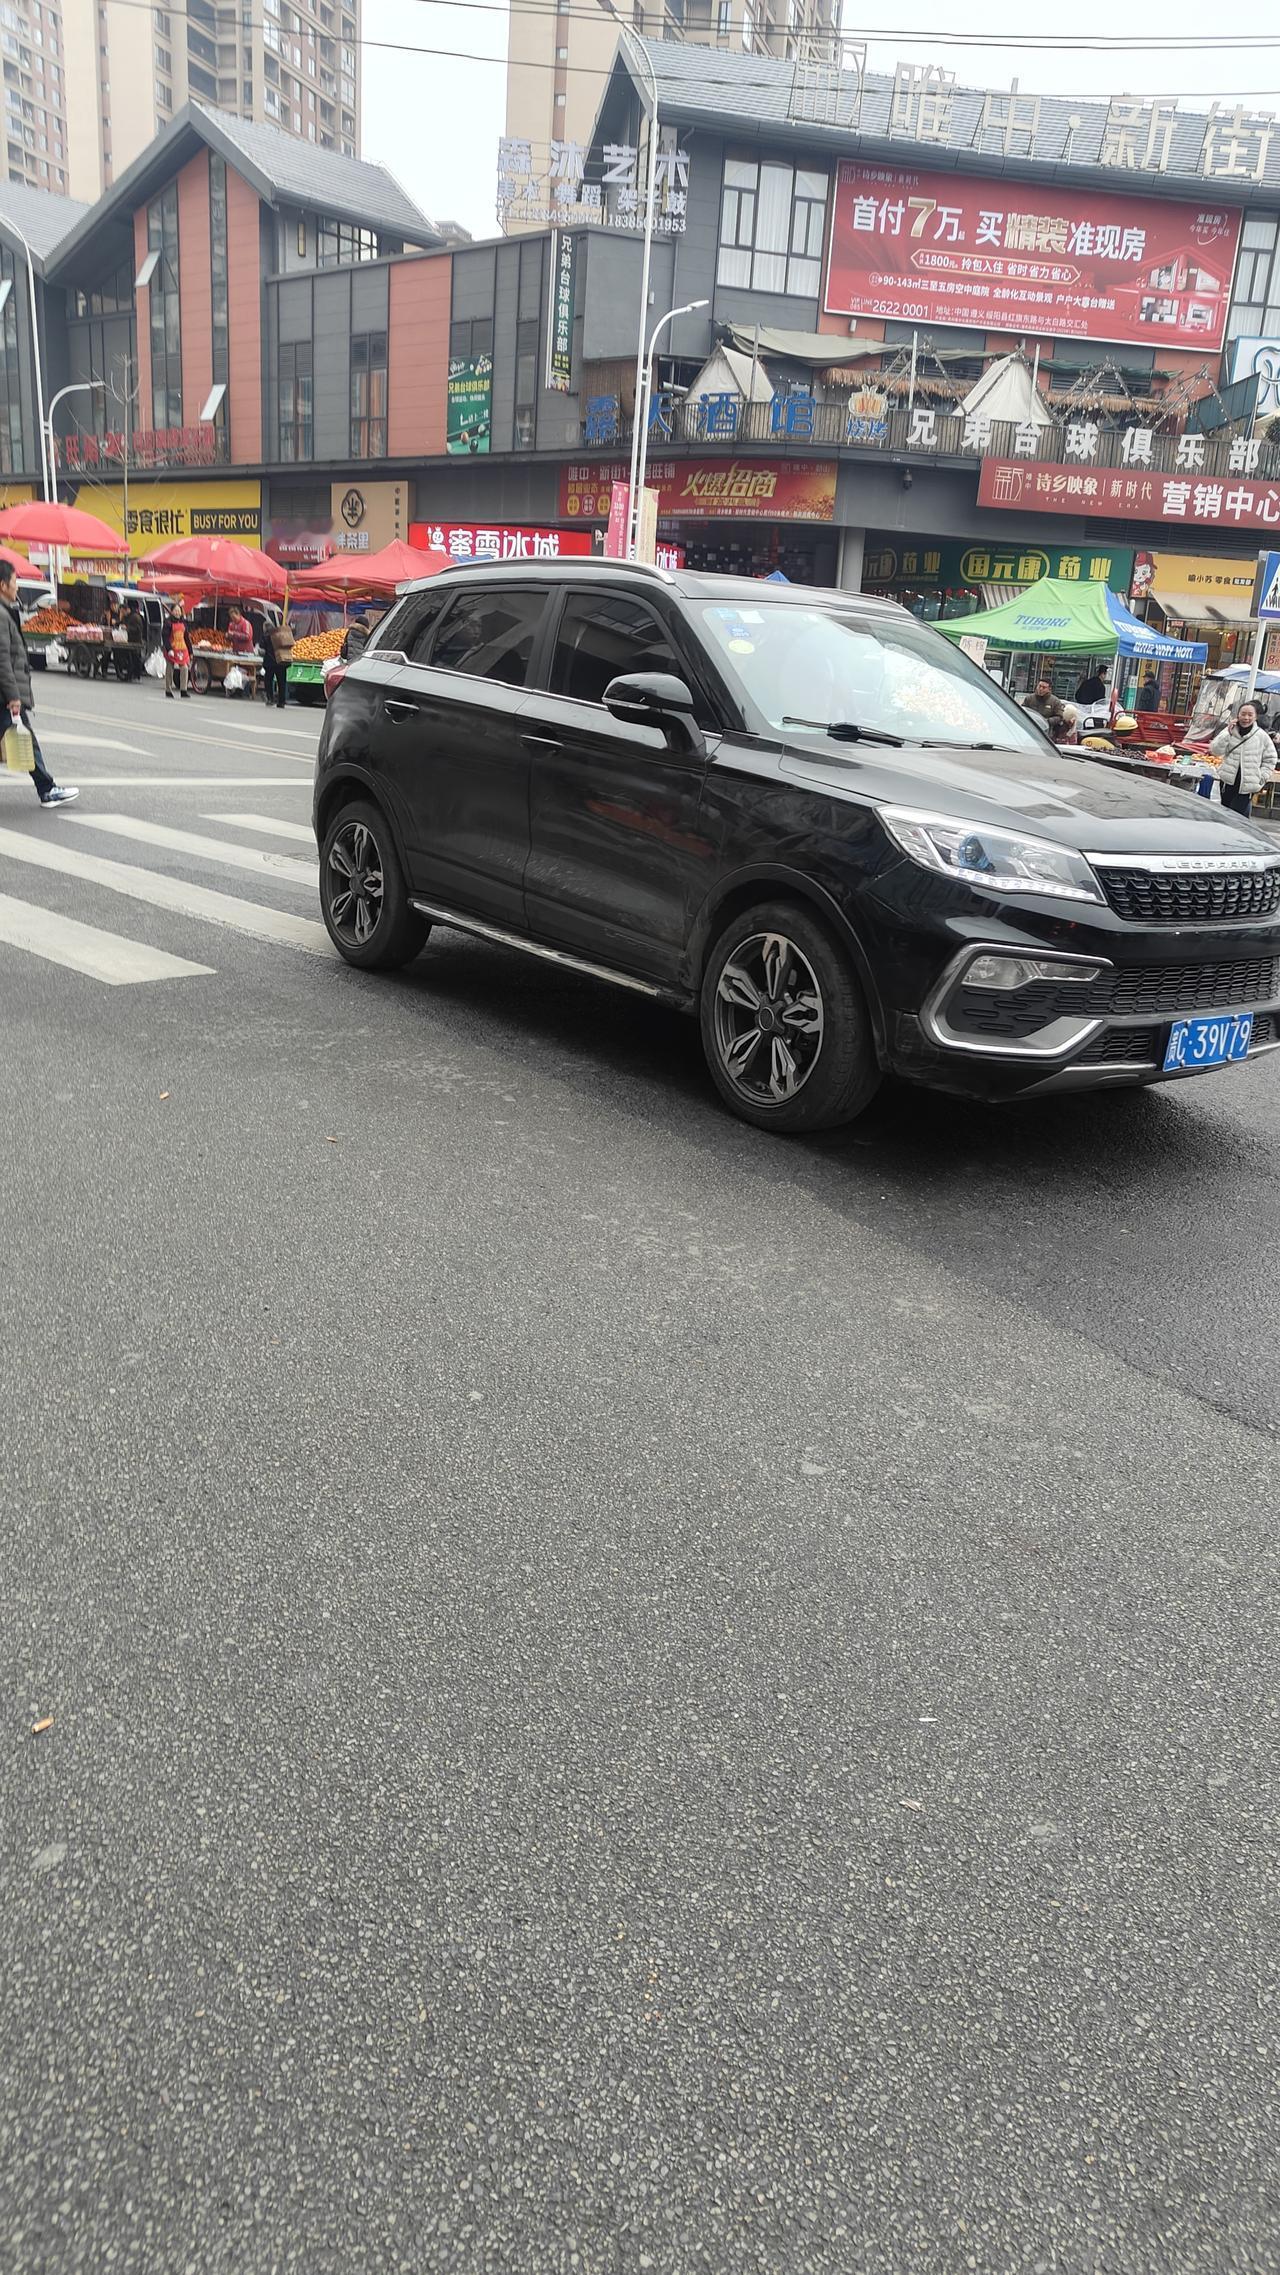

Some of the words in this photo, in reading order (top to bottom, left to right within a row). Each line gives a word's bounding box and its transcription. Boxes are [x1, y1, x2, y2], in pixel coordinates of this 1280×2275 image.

[976, 210, 1146, 262] 买精装准现房
[961, 257, 1004, 274] 拎包入住
[556, 235, 572, 352] 兄弟台球俱乐部
[872, 299, 899, 315] 2622
[902, 303, 929, 317] 0001
[906, 408, 1261, 474] 兄弟台球俱乐部
[680, 461, 778, 498] 火爆招商
[1036, 473, 1098, 496] 诗乡映象
[1110, 479, 1152, 501] 新时代
[1162, 480, 1280, 522] 营销中心
[127, 508, 185, 534] 零食很忙
[193, 514, 217, 529] BUSY
[219, 514, 237, 529] FOR
[239, 513, 258, 529] YOU
[449, 528, 559, 558] 蜜雪冰城
[967, 554, 1043, 581] 国元康
[1058, 555, 1112, 581] 药业
[1013, 614, 1071, 628] TUBORG
